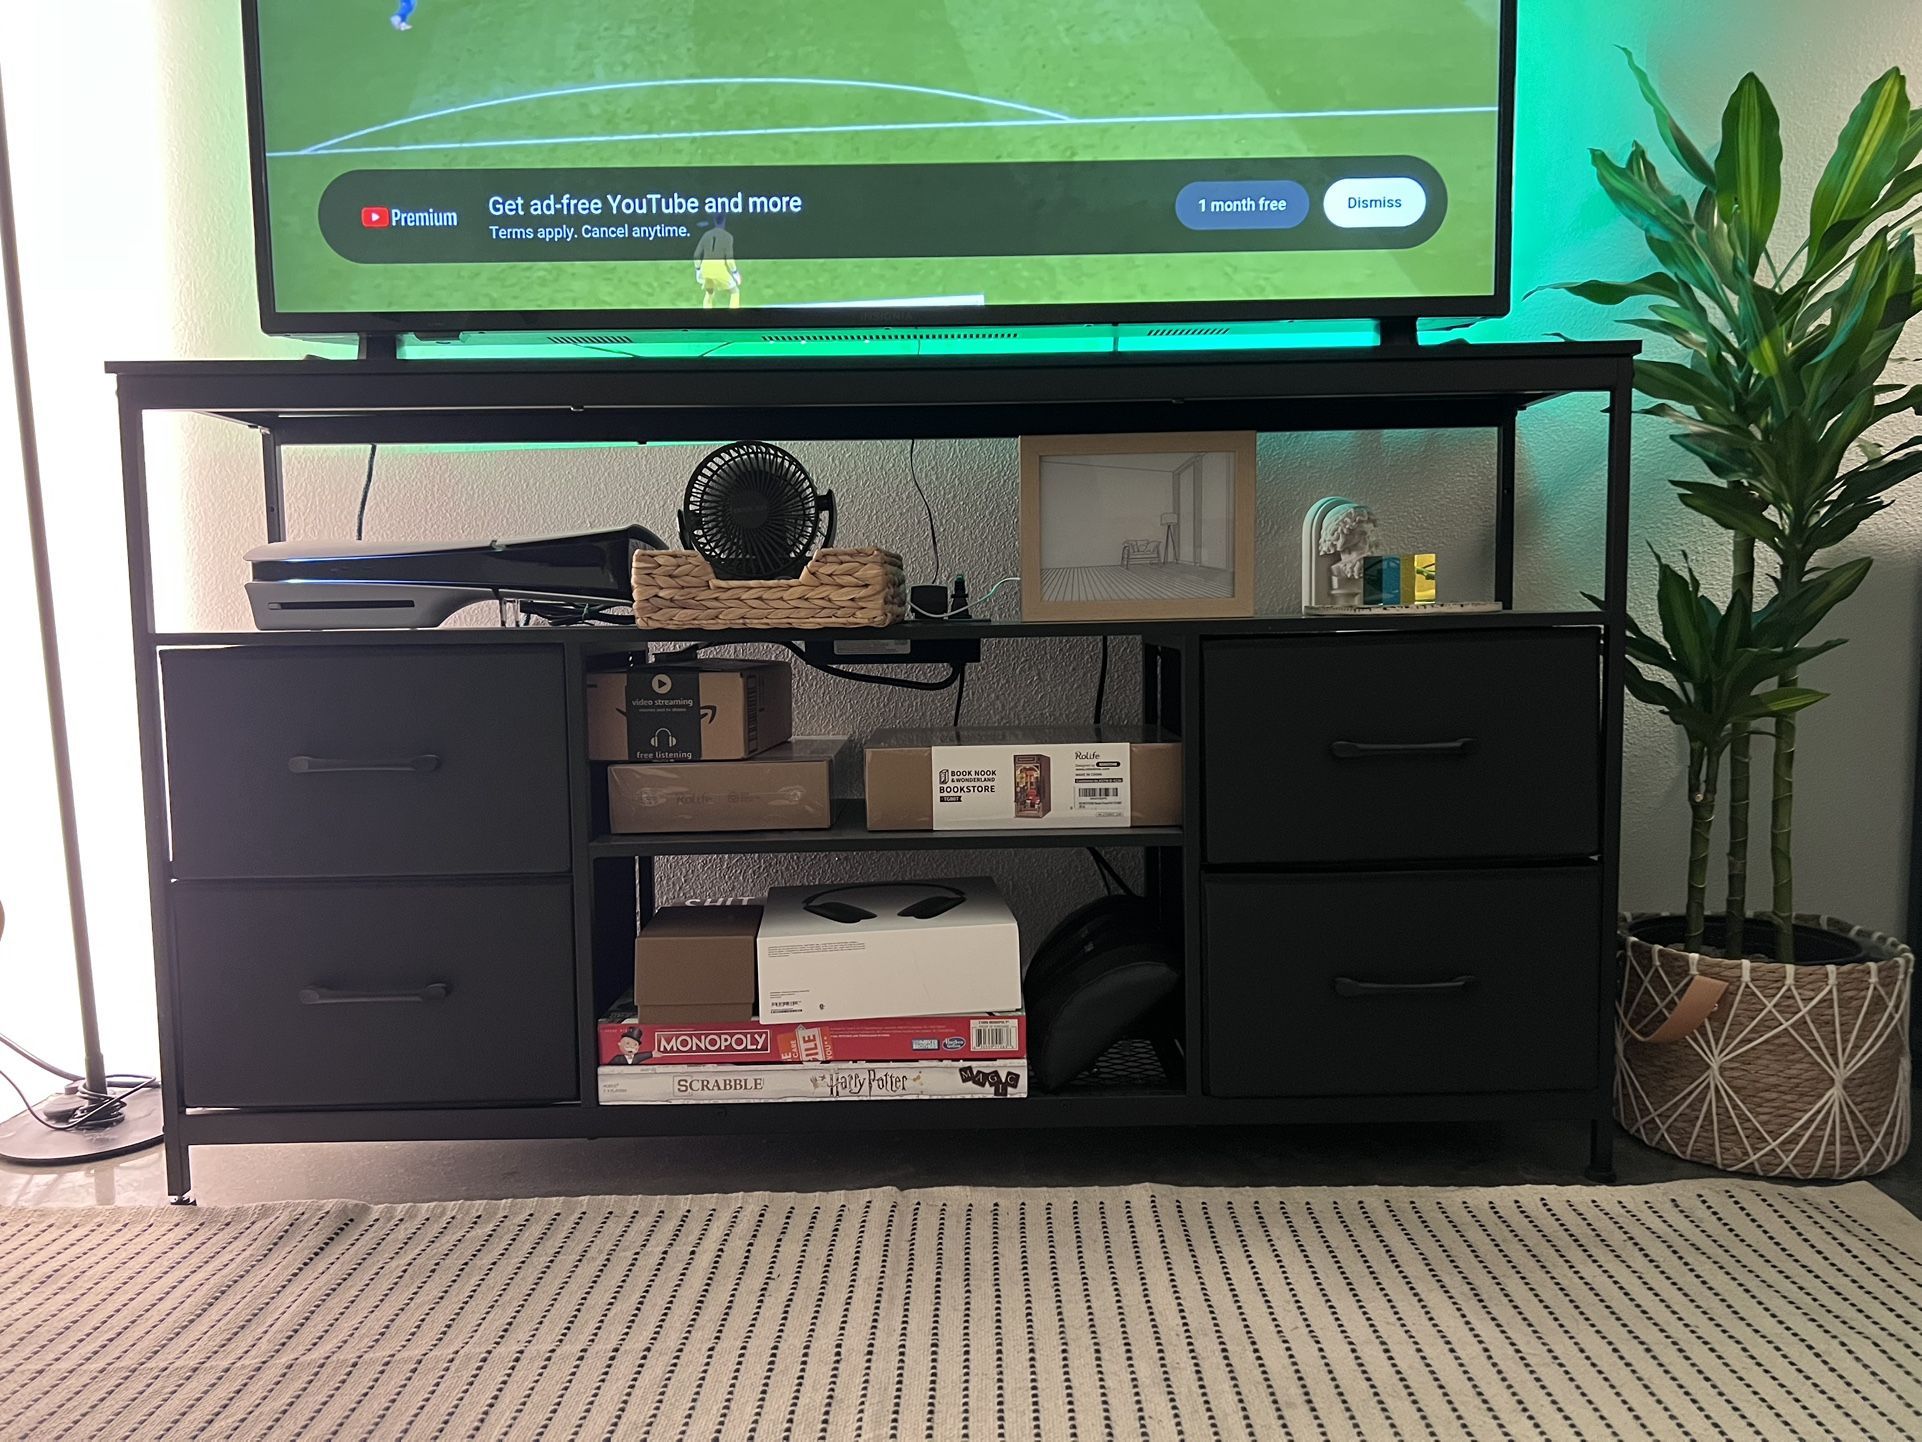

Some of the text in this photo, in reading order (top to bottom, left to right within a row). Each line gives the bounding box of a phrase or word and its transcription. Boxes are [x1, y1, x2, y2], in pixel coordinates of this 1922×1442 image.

[488, 191, 802, 215] Get ad-free YouTube and more
[1198, 196, 1287, 212] 1 month free
[1347, 195, 1403, 209] Dismiss
[391, 208, 458, 226] Premium
[489, 223, 691, 241] Terms apply. Cancel anytime.
[631, 698, 693, 707] video streaming
[636, 751, 692, 760] free listening
[1075, 751, 1101, 760] Rolife
[974, 769, 997, 777] NOOK
[939, 785, 995, 794] BOOKSTORE
[658, 1032, 766, 1052] MONOPOLY
[803, 1034, 819, 1061] ILE
[677, 1077, 763, 1092] SCRABBLE
[827, 1069, 908, 1097] Harry Potter
